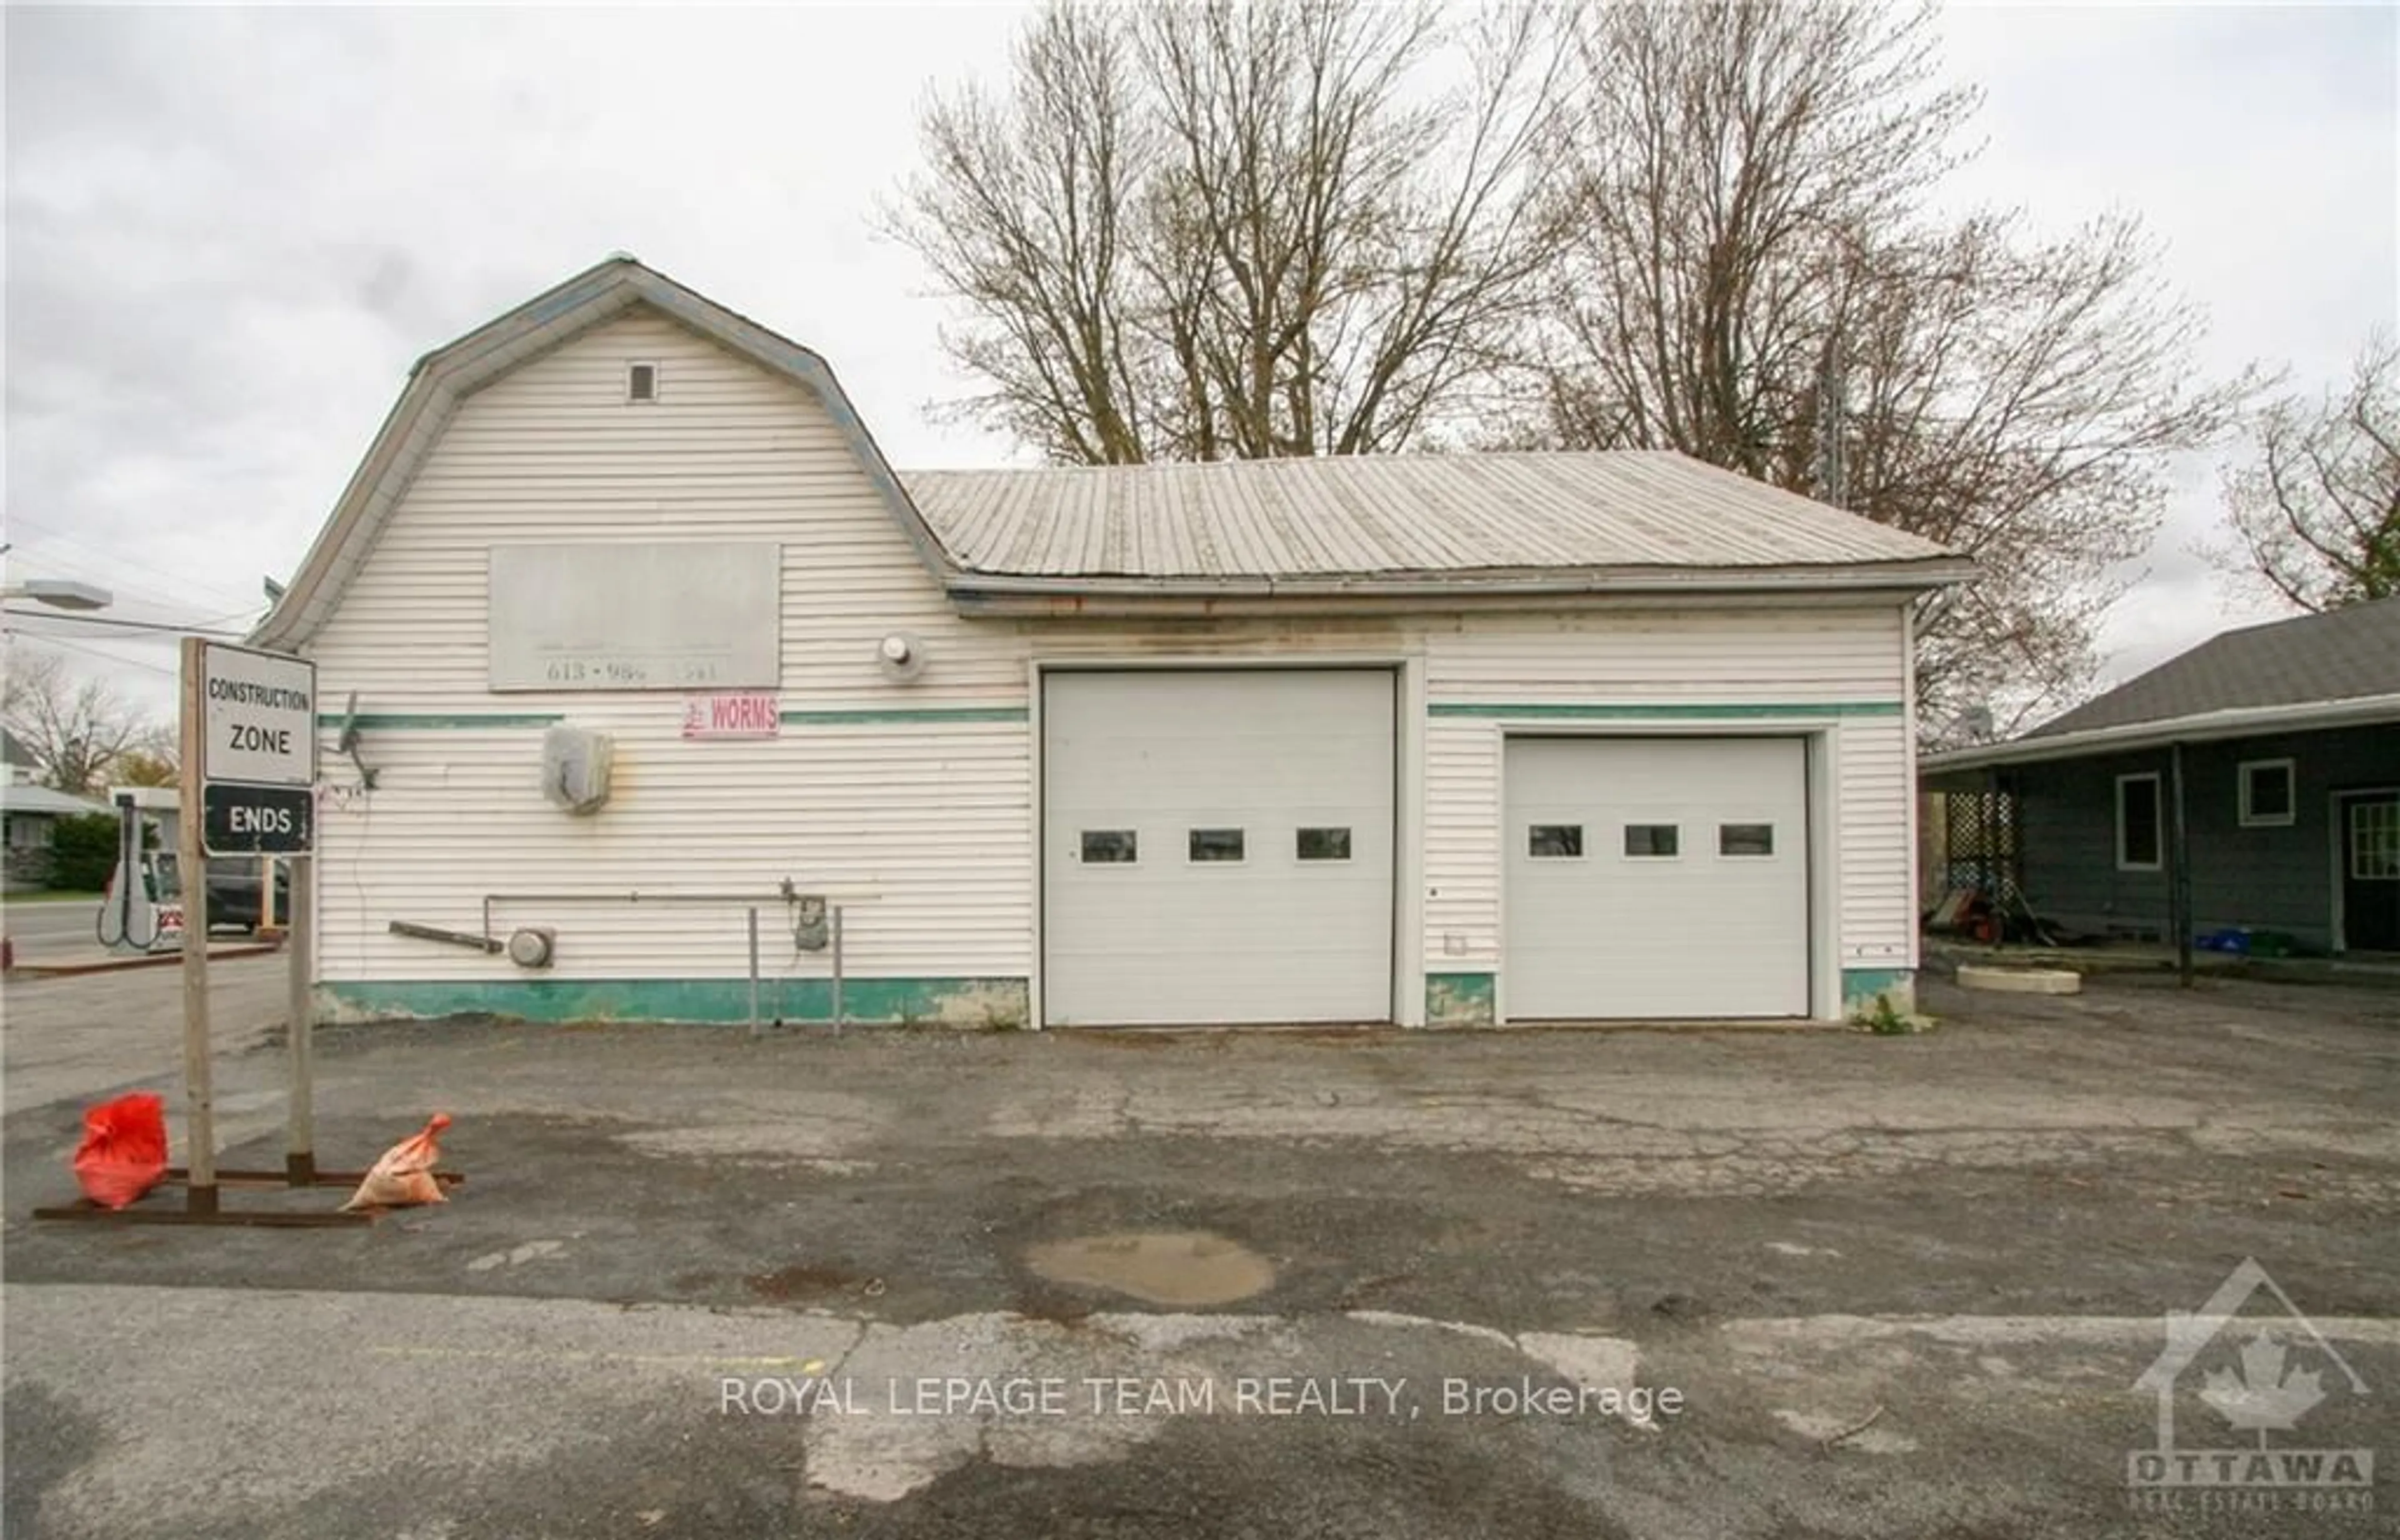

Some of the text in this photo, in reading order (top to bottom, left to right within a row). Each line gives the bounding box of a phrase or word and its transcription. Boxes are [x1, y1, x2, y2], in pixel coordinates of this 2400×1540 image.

[209, 678, 309, 711] CONSTRUCTION
[712, 698, 778, 730] WORMS
[229, 724, 291, 754] ZONE
[229, 806, 292, 834] ENDS
